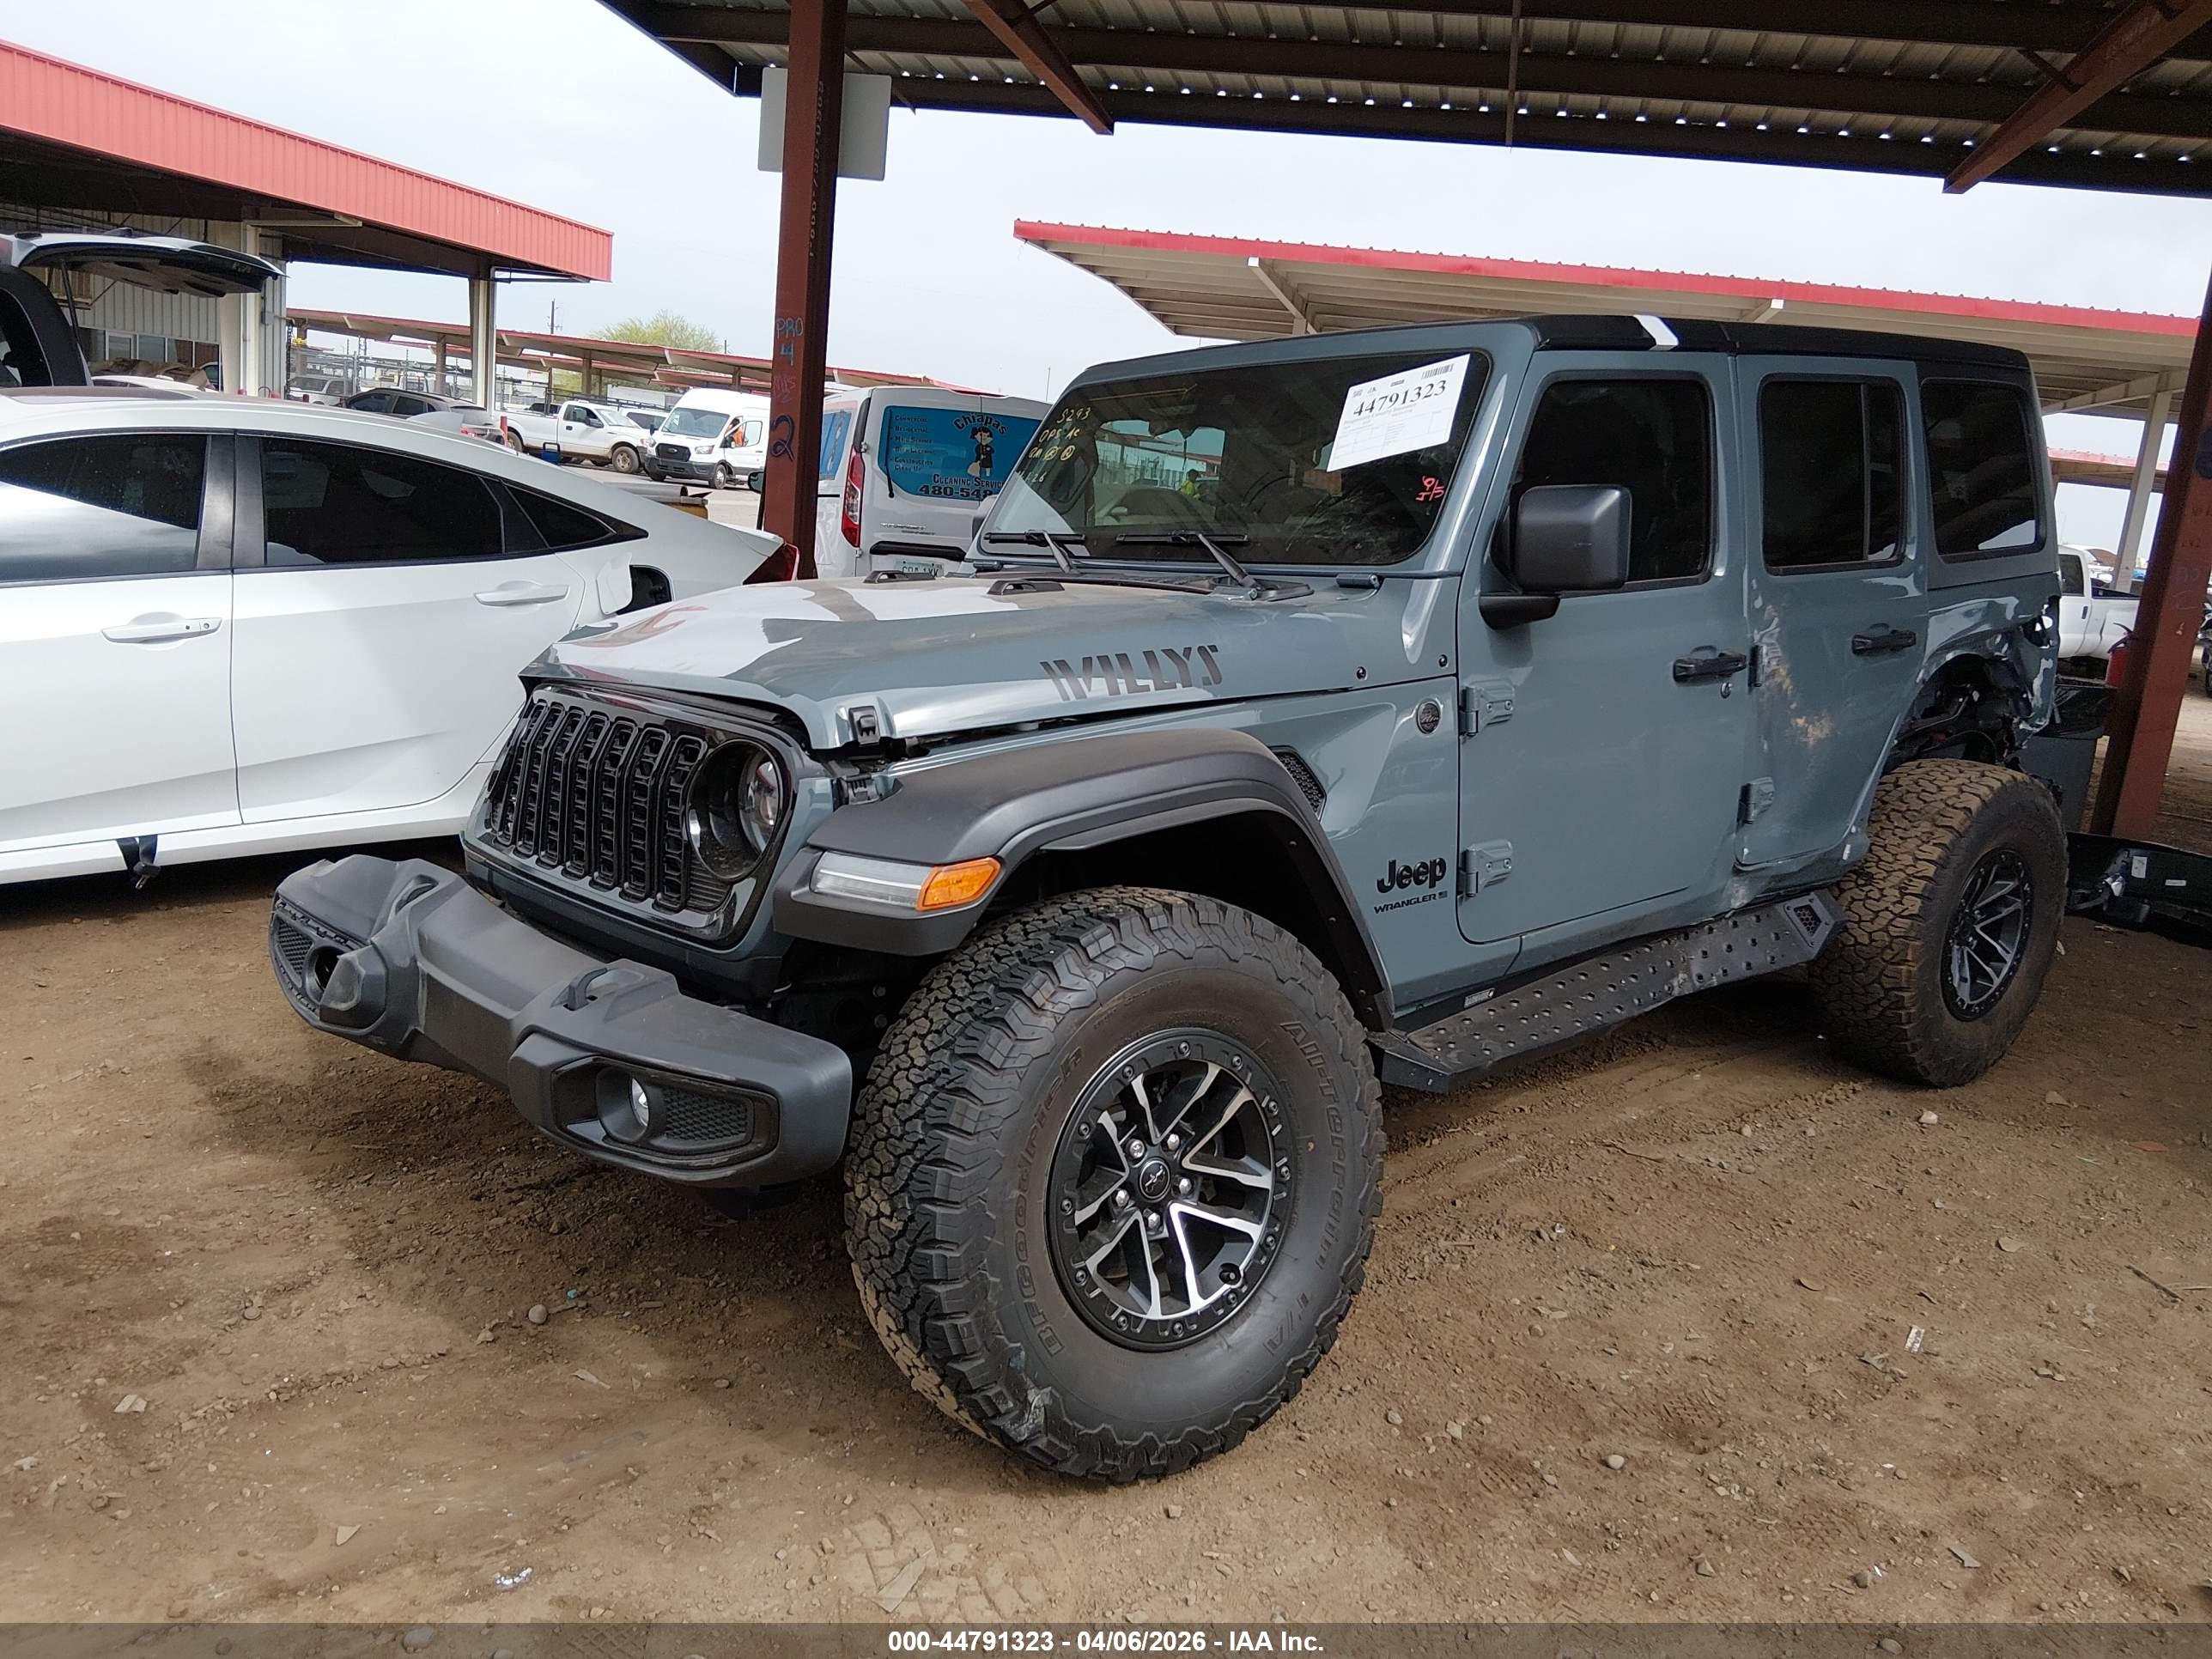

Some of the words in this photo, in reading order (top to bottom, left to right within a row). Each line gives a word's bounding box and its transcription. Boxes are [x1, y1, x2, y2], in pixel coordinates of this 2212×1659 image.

[1352, 380, 1447, 416] 44791323
[953, 413, 1007, 434] Chiapas
[1039, 644, 1223, 702] WILLYS
[1376, 857, 1447, 894] Jeep
[1374, 891, 1437, 915] WRANGLER
